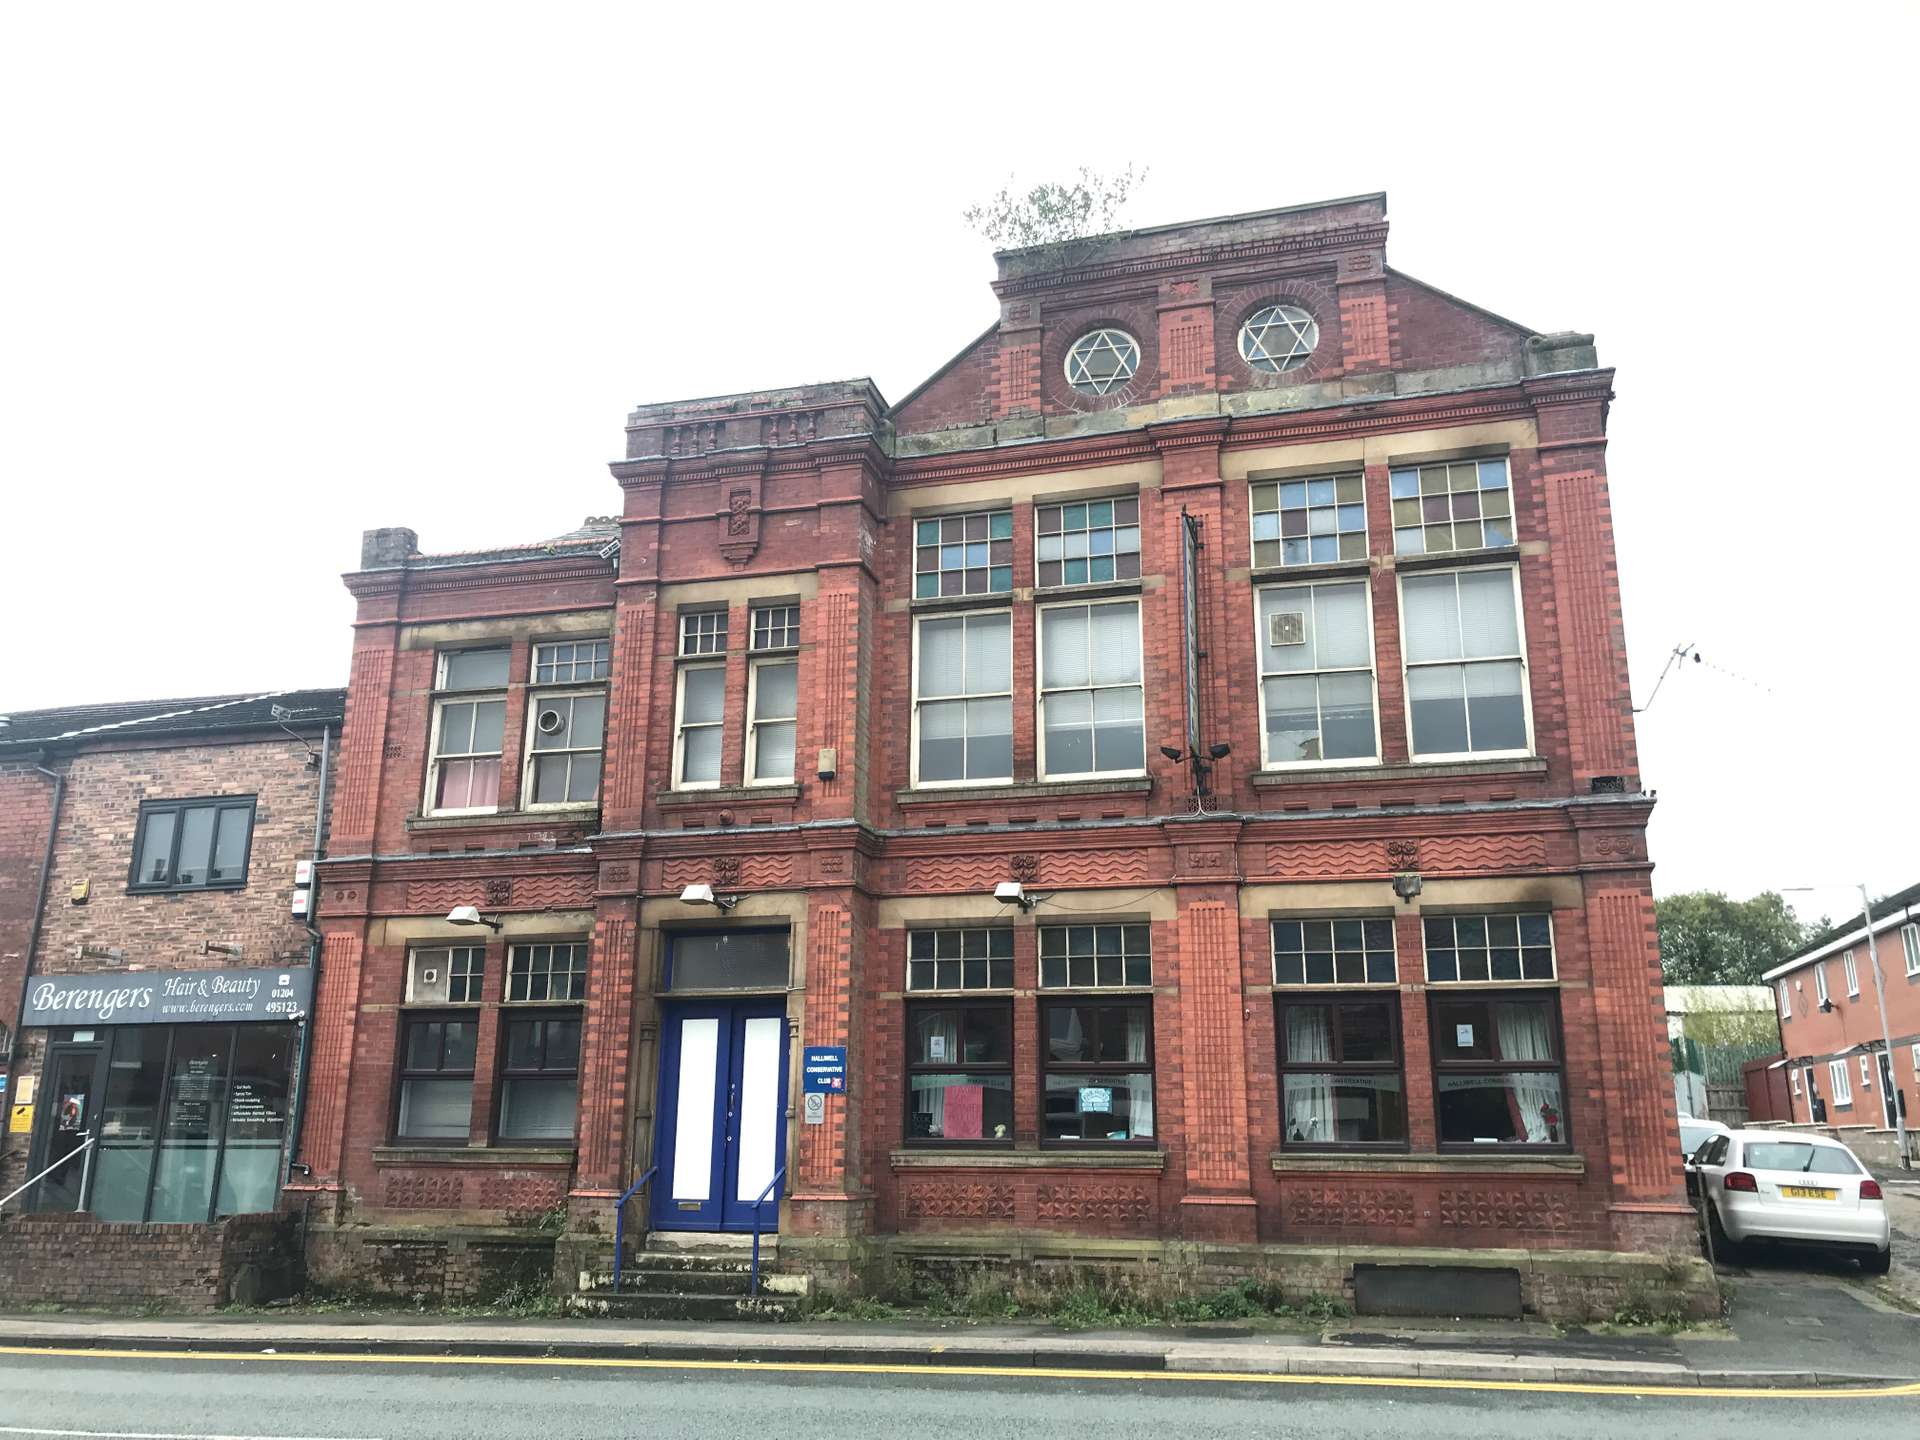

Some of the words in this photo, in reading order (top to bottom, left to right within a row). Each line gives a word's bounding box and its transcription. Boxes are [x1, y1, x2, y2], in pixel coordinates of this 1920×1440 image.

[162, 976, 197, 997] Hair
[198, 978, 210, 998] &
[211, 975, 261, 999] Beauty
[271, 988, 294, 999] 01204
[32, 982, 153, 1020] Berengers
[162, 1000, 253, 1016] www.berengers.com
[265, 1001, 297, 1014] 495123
